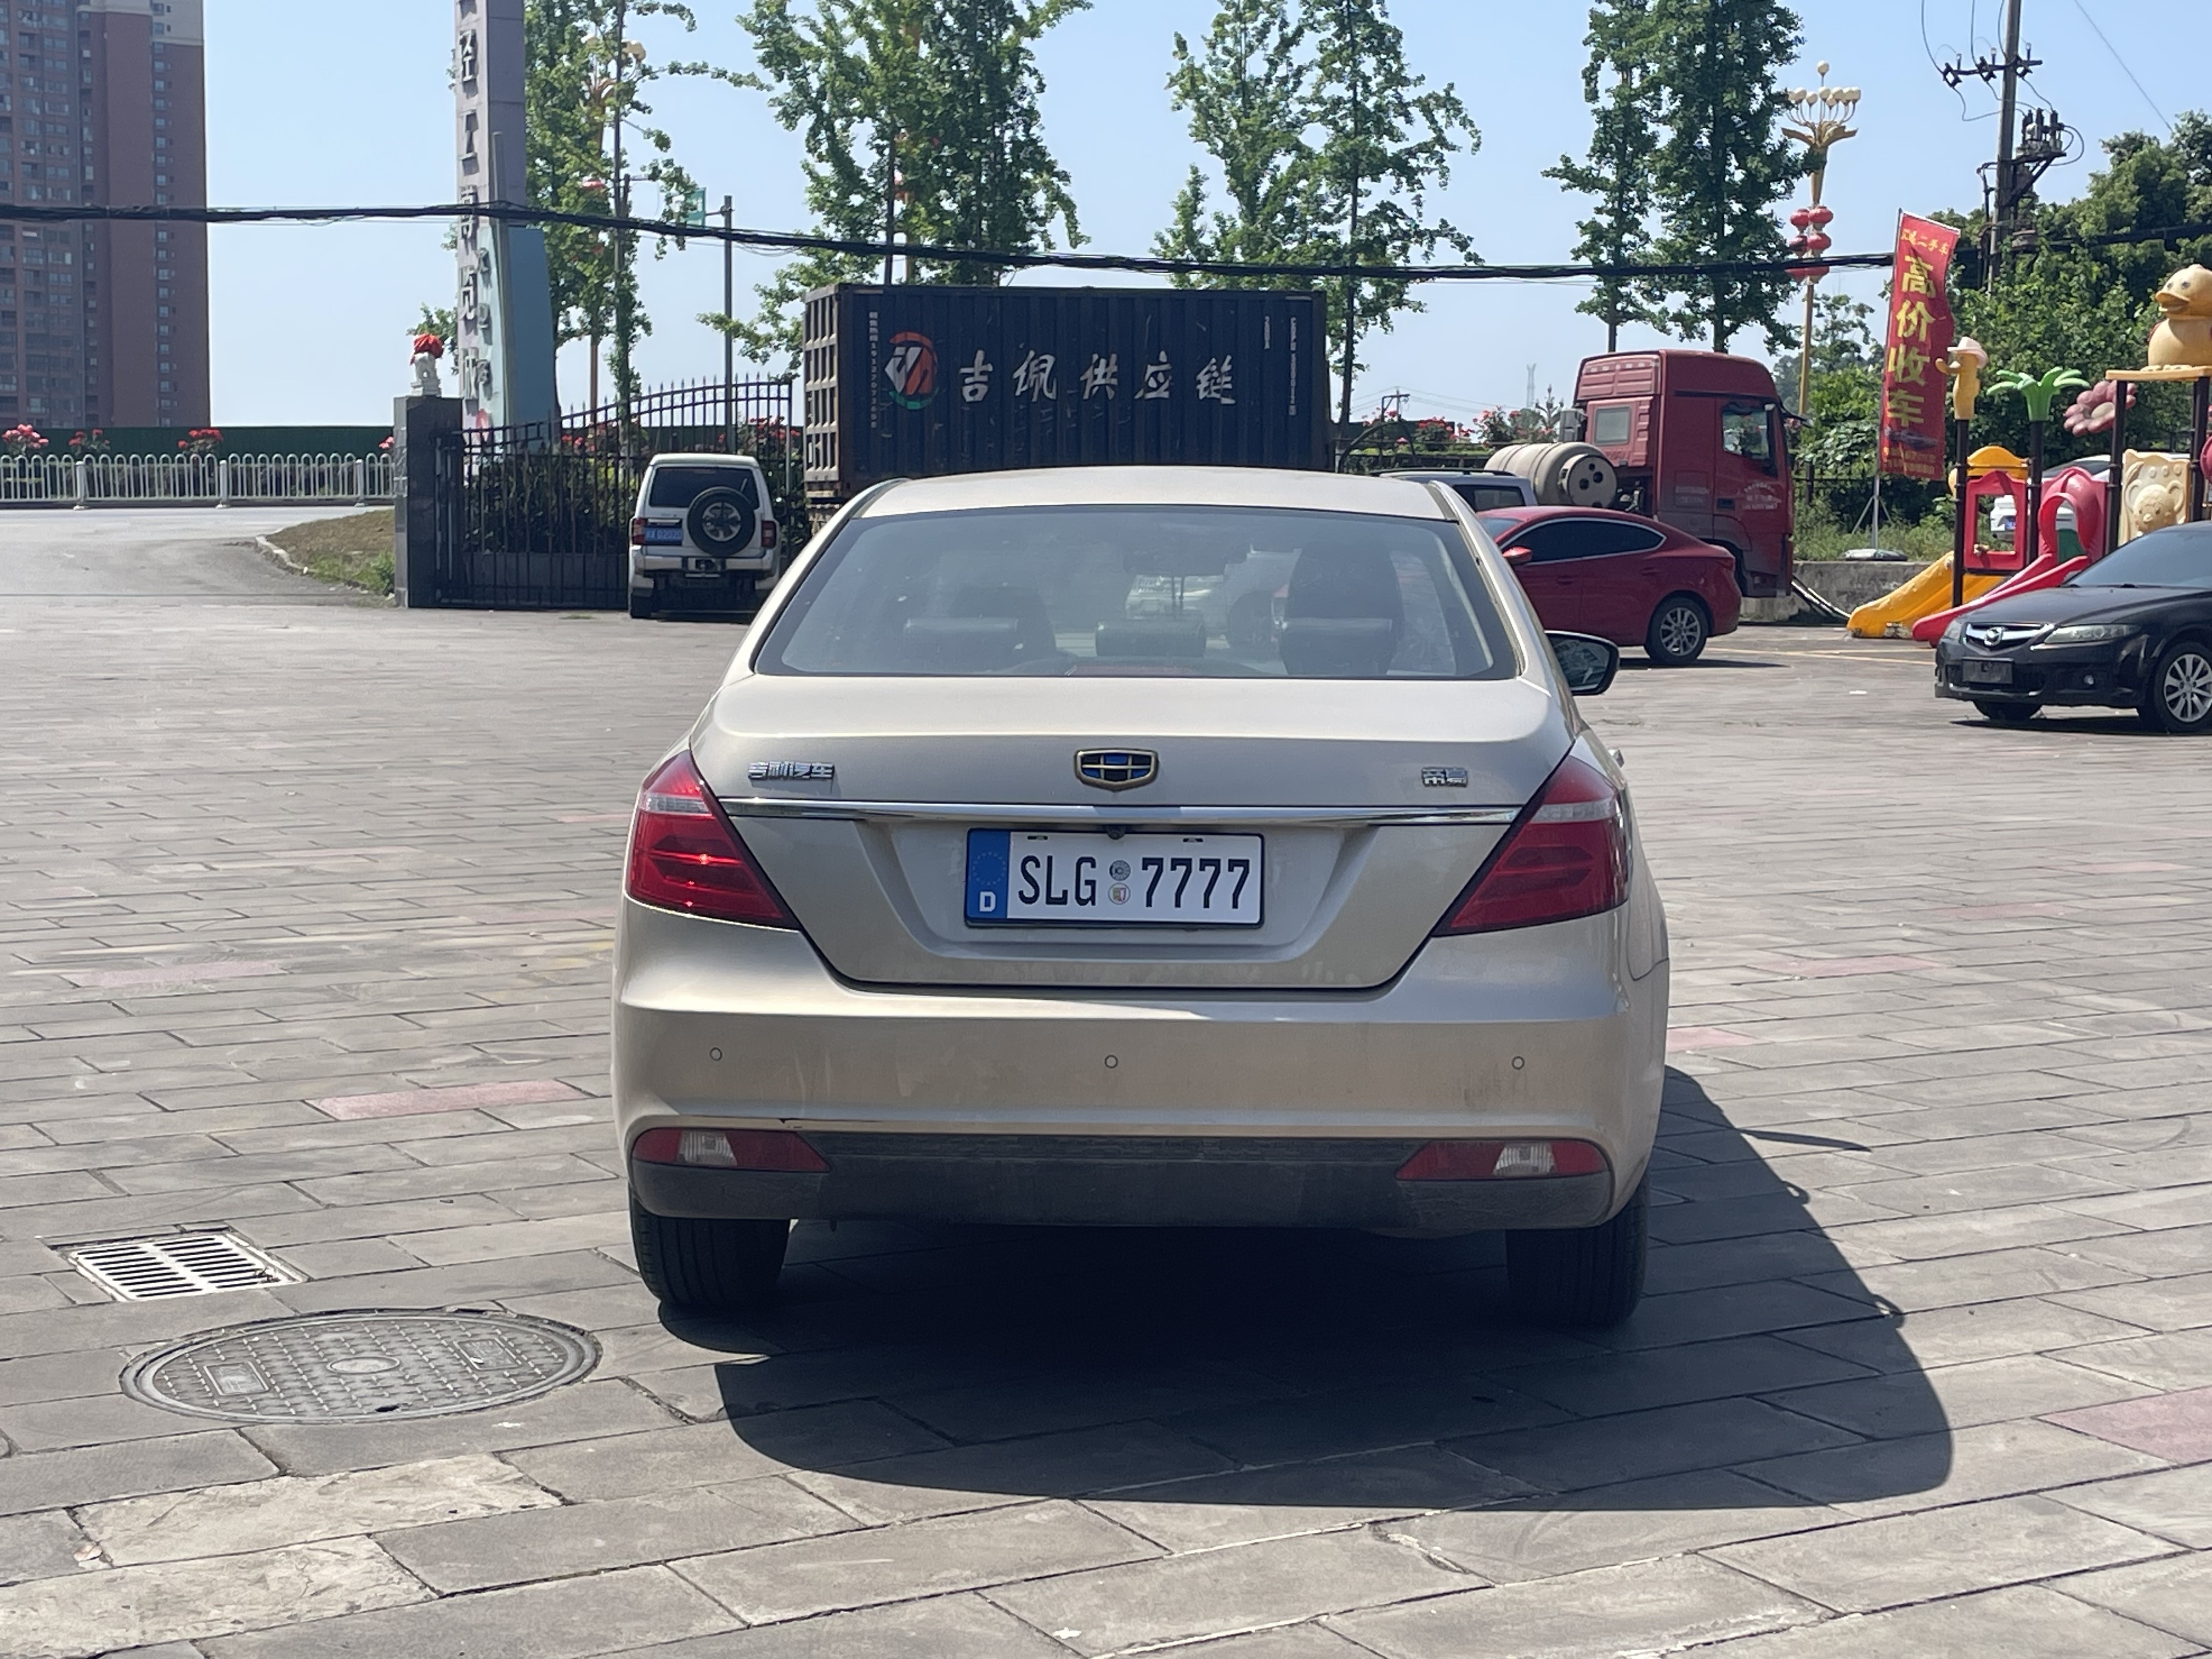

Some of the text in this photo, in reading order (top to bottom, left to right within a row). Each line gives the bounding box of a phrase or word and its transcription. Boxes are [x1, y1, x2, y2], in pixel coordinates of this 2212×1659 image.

[1888, 254, 1937, 427] 高价收车
[958, 349, 1236, 404] 吉佩供应链
[979, 891, 996, 912] D
[1018, 855, 1250, 909] SLG 7777
